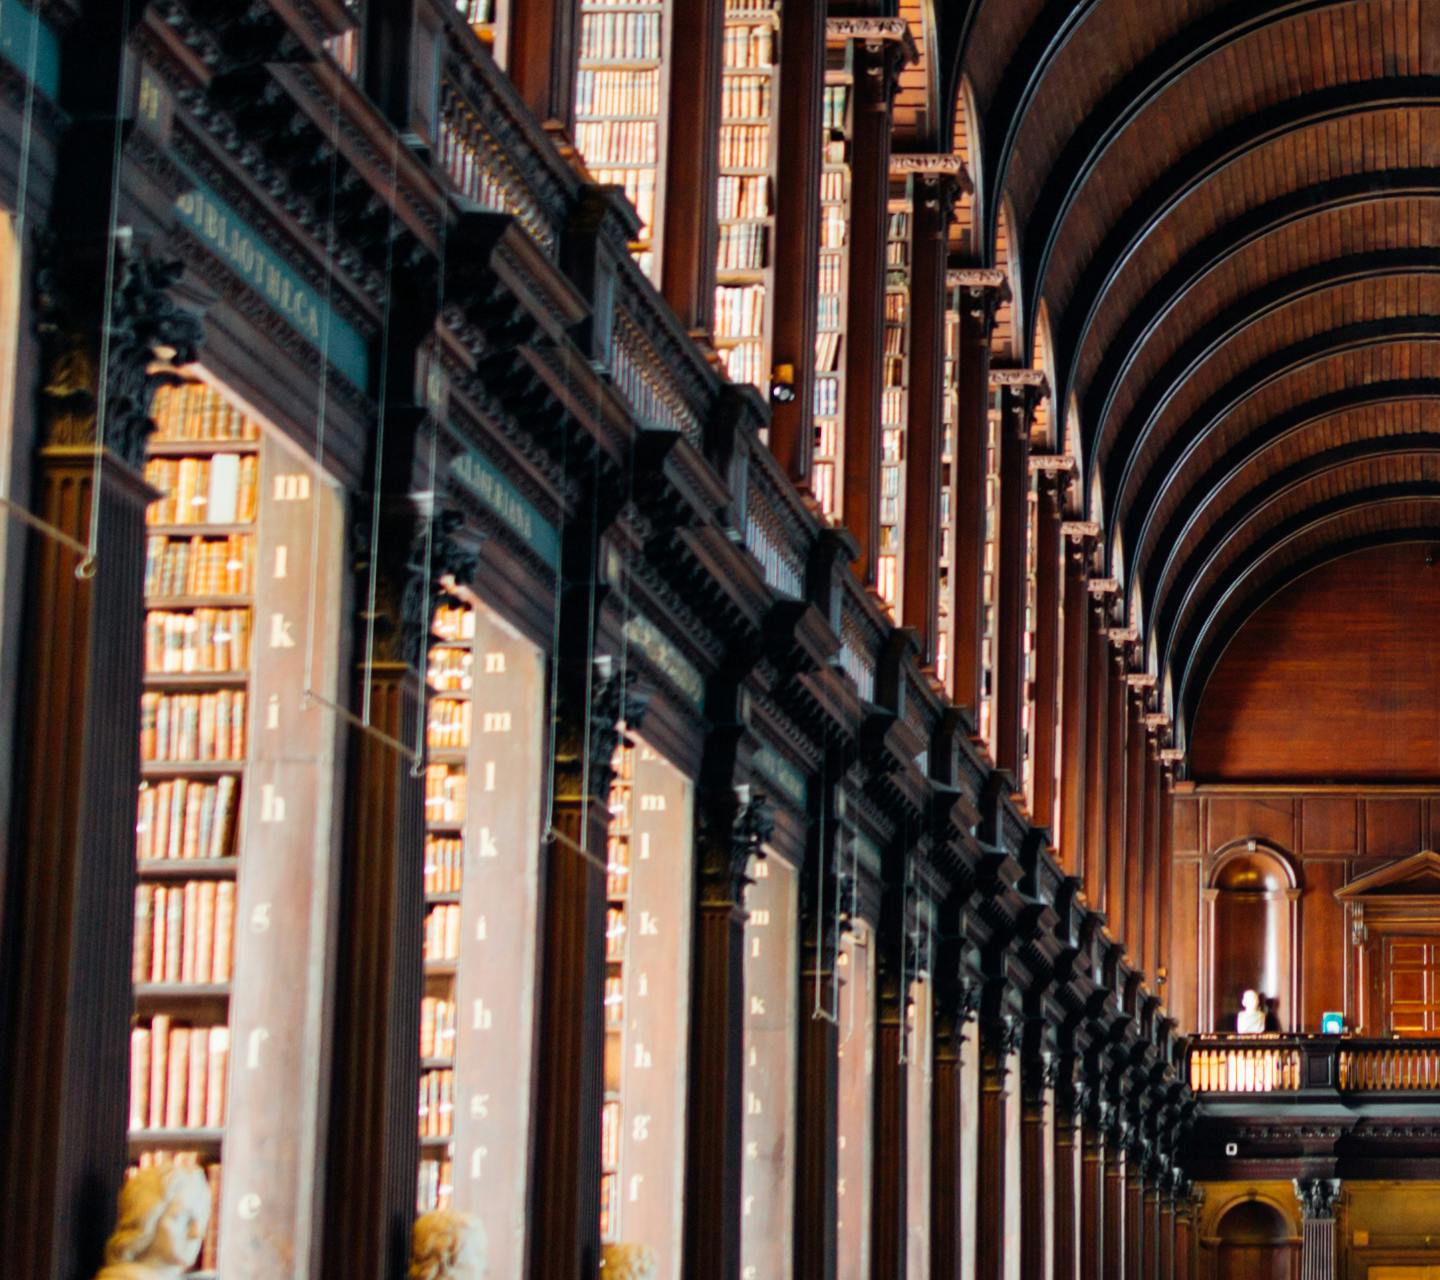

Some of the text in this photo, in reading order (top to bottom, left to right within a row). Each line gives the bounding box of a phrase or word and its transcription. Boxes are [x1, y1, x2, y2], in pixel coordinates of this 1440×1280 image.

[273, 474, 309, 501] m
[274, 545, 287, 578] l
[270, 615, 294, 648] k
[485, 652, 505, 673] n
[268, 694, 280, 729] i
[484, 712, 511, 731] m
[485, 763, 495, 791] l
[261, 785, 285, 823] h
[640, 794, 666, 812] m
[480, 828, 497, 858] k
[639, 833, 649, 860] l
[476, 916, 487, 940] i
[640, 912, 658, 935] k
[750, 910, 769, 925] m
[638, 973, 648, 996] i
[472, 998, 492, 1029] h
[751, 996, 765, 1015] k
[247, 1027, 268, 1068] f
[634, 1044, 652, 1069] h
[748, 1092, 762, 1114] h
[633, 1116, 651, 1140] g
[472, 1147, 487, 1179] f
[629, 1175, 643, 1201] f
[238, 1193, 260, 1220] e
[744, 1195, 755, 1216] f
